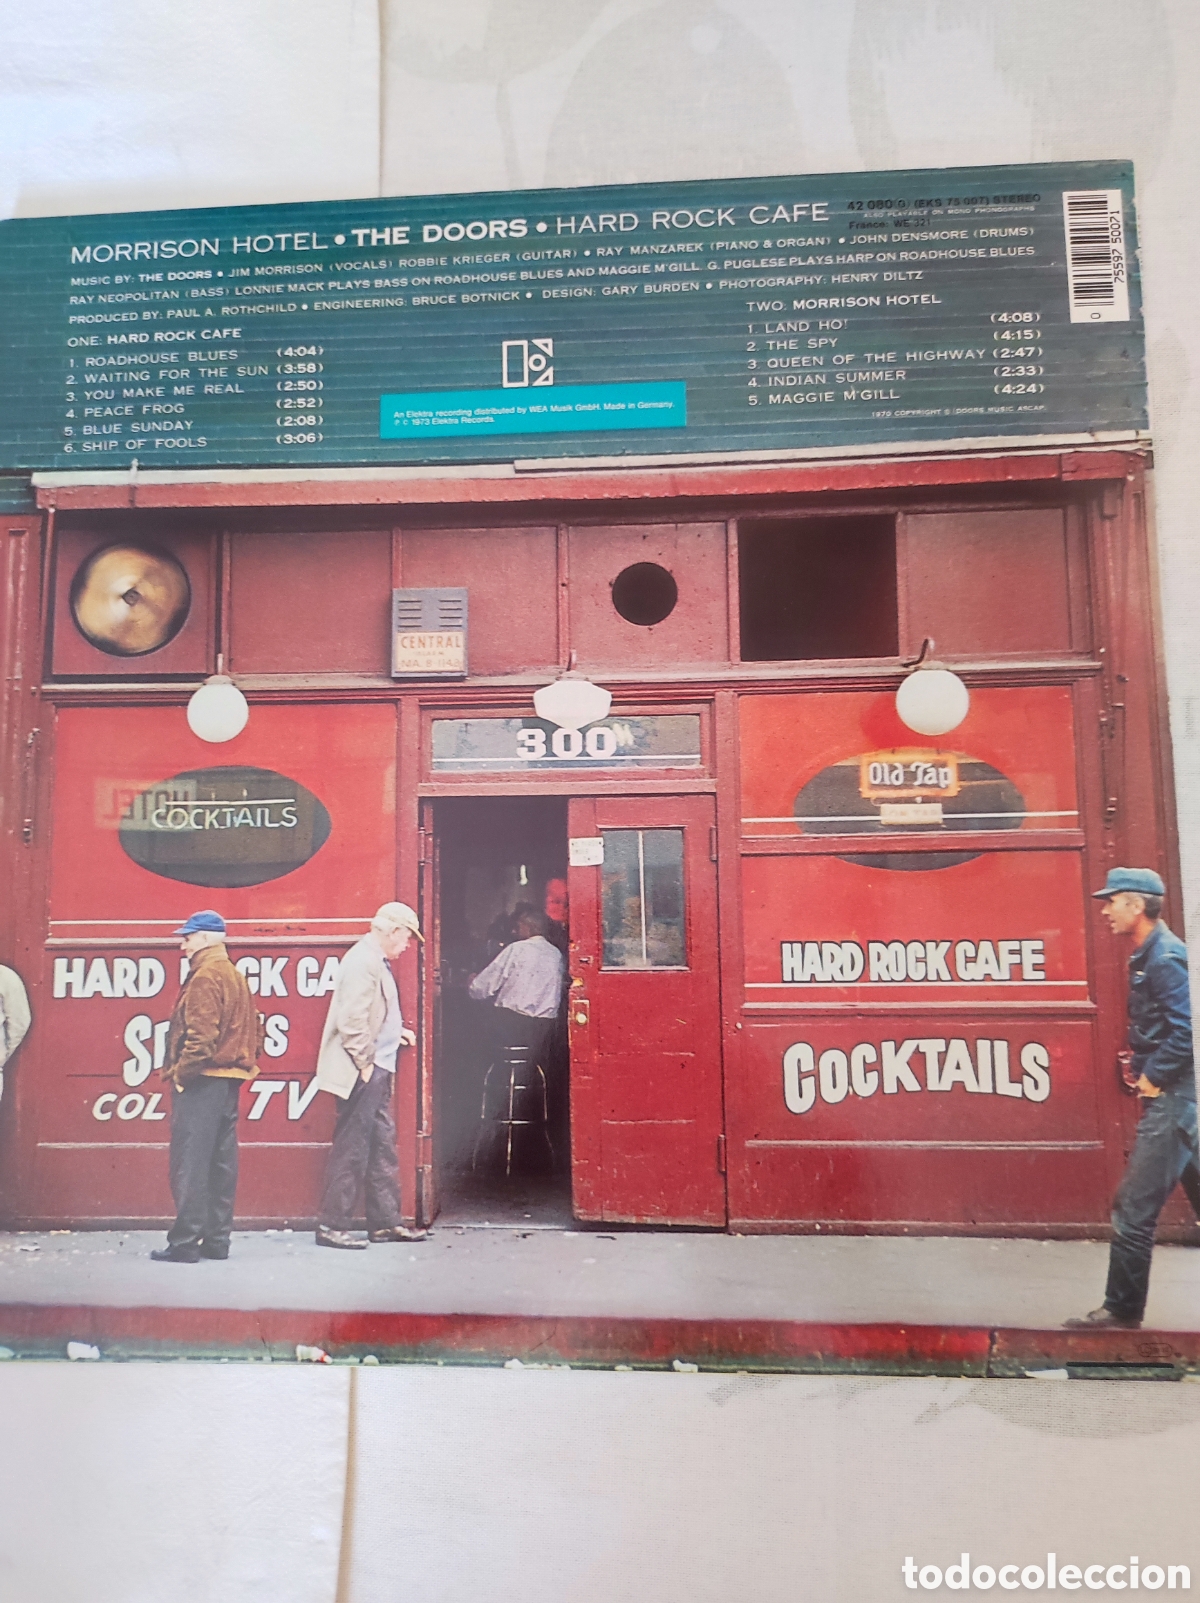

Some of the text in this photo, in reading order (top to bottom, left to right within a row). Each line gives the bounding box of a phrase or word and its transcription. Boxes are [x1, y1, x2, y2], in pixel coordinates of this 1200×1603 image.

[71, 202, 830, 264] MORRISON HOTEL THE DOORS HARD ROCK CAFE
[71, 227, 1034, 287] MUSIC BY: THE DOORS JIM MORRISON (VOCALS) ROBBIE KRIEGER (GUITAR) RAY MANZAREK (PIANO & ORGAN) JOHN DENSMORE (DRUMS)
[1110, 210, 1125, 283] 75597 50071
[69, 294, 93, 305] RAY
[98, 290, 180, 303] NEOPOLITAN
[185, 287, 229, 299] (BASS)
[235, 283, 284, 296] LONNIE
[288, 281, 325, 293] MACK
[328, 279, 370, 291] PLAYS
[374, 277, 408, 289] BASS
[411, 276, 431, 287] ON
[434, 271, 517, 285] ROADHOUSE
[520, 269, 564, 280] BLUES
[567, 267, 595, 278] AND
[598, 264, 650, 276] MAGGIE
[707, 260, 721, 270] G.
[723, 257, 786, 270] PUGLESE
[788, 254, 833, 266] PLAYS
[836, 253, 874, 264] HARP
[876, 252, 896, 262] ON
[899, 248, 986, 261] ROADHOUSE
[989, 246, 1035, 257] BLUES
[68, 270, 924, 325] PRODUCED BY: PAUL A. ROTHCHILD ENGINEERING: BRUCE BOTNICK DESIGN: GARY BURDEN PHOTOGRAPHY: HENRY DILTZ
[746, 294, 942, 312] TWO: MORRISON HOTEL
[765, 311, 1041, 334] LAND HO! (4:08)
[67, 328, 242, 348] ONE: HARD ROCK CAFE
[766, 328, 1041, 350] THE SPY (4:15)
[85, 345, 324, 368] ROADHOUSE BLUES (4:04)
[767, 346, 1043, 369] QUEEN OF THE HIGHWAY (2:47)
[84, 362, 324, 384] WAITING FOR THE SUN (3:58)
[768, 365, 1044, 387] INDIAN SUMMER (2:33)
[84, 380, 324, 400] YOU MAKE ME REAL (2:50)
[768, 391, 835, 405] MAGGIE
[994, 383, 1045, 396] (4:24)
[84, 397, 324, 418] PEACE FROG (2:52)
[406, 410, 433, 418] Elektra
[435, 409, 472, 417] recording
[474, 407, 515, 415] distributed
[516, 406, 527, 415] by
[637, 401, 675, 409] Germany.
[82, 415, 324, 436] BLUE SUNDAY (2:08)
[82, 432, 324, 452] SHIP OF FOOLS (3:06)
[400, 636, 461, 649] CENTRAL
[516, 726, 617, 759] 300
[869, 761, 953, 788] Old Tap
[152, 807, 298, 829] COCKTAILS
[781, 939, 1046, 982] HARD ROCK CAFE
[53, 956, 341, 998] HARD CA
[782, 1037, 1050, 1115] COCKTAILS
[92, 1077, 318, 1121] COL TV
